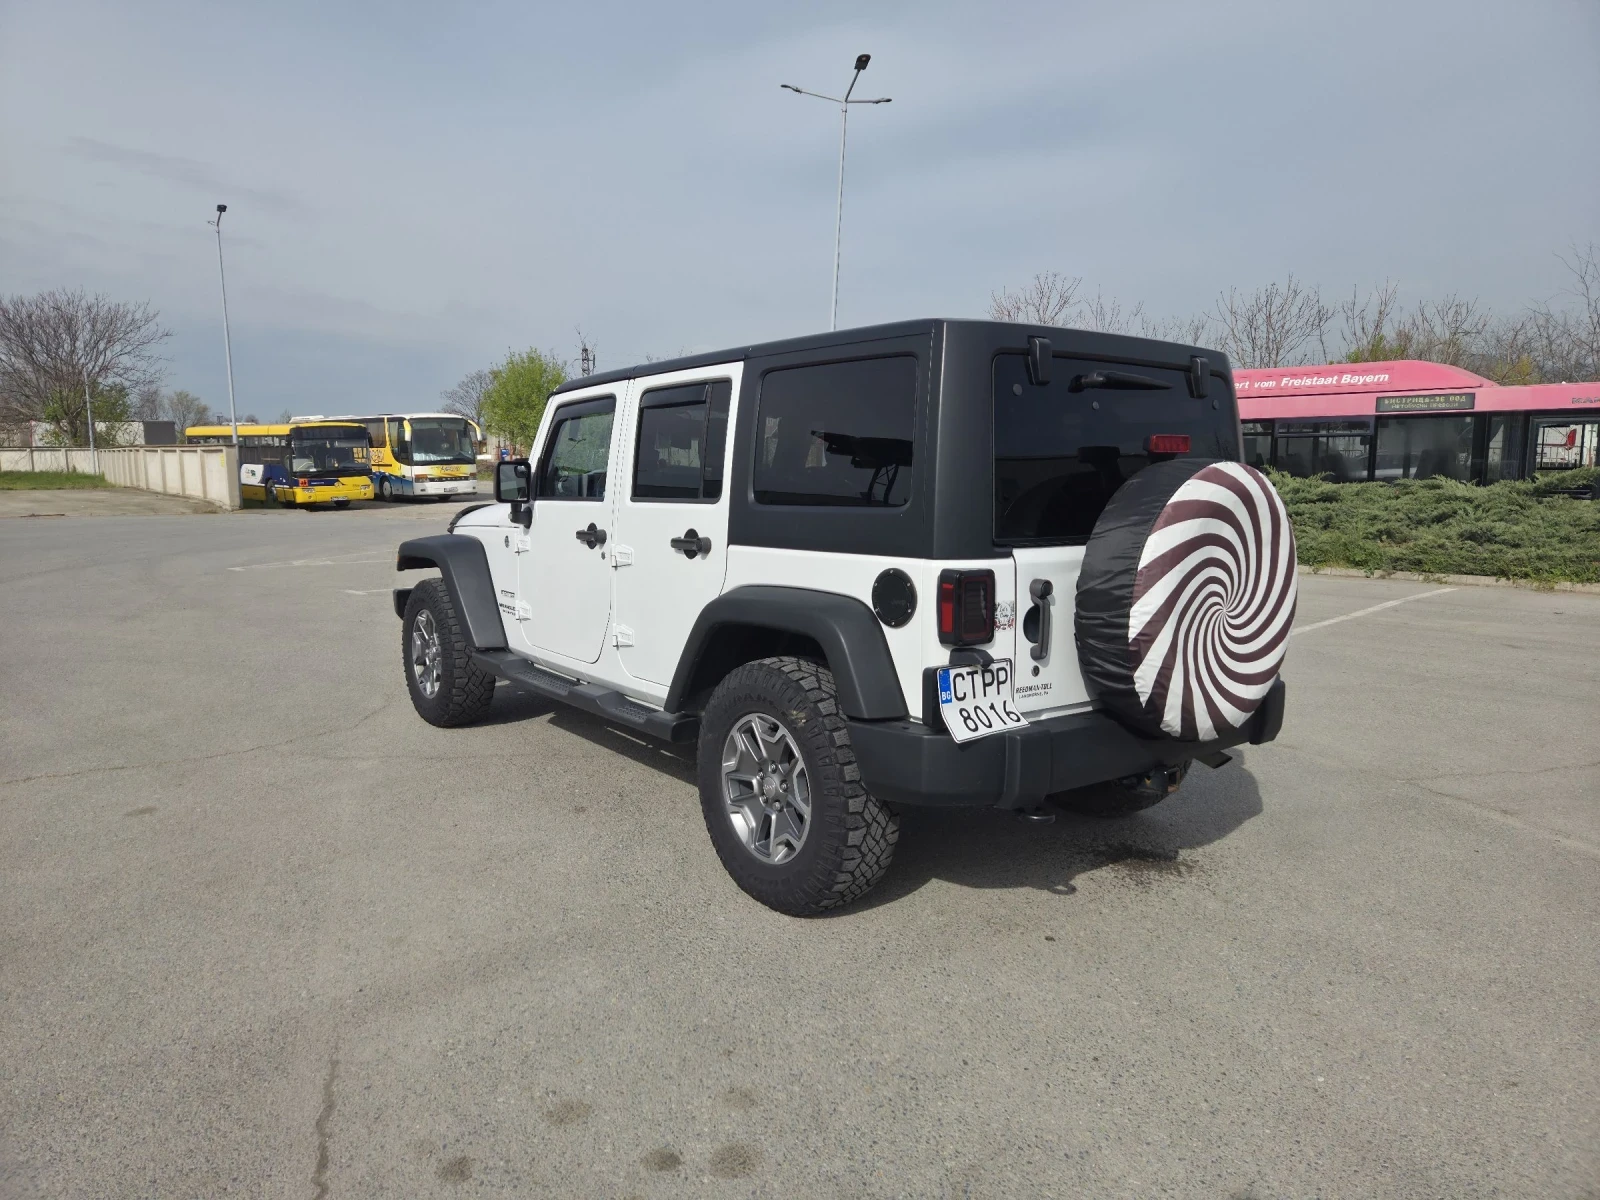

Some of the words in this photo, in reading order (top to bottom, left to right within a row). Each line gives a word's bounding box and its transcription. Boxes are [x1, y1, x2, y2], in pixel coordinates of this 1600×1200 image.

[1254, 380, 1276, 388] vom
[1281, 375, 1338, 387] Freistaat
[1341, 373, 1389, 385] Bayern
[953, 666, 1008, 701] CTPP
[942, 691, 951, 700] BG
[959, 700, 1021, 732] 8016
